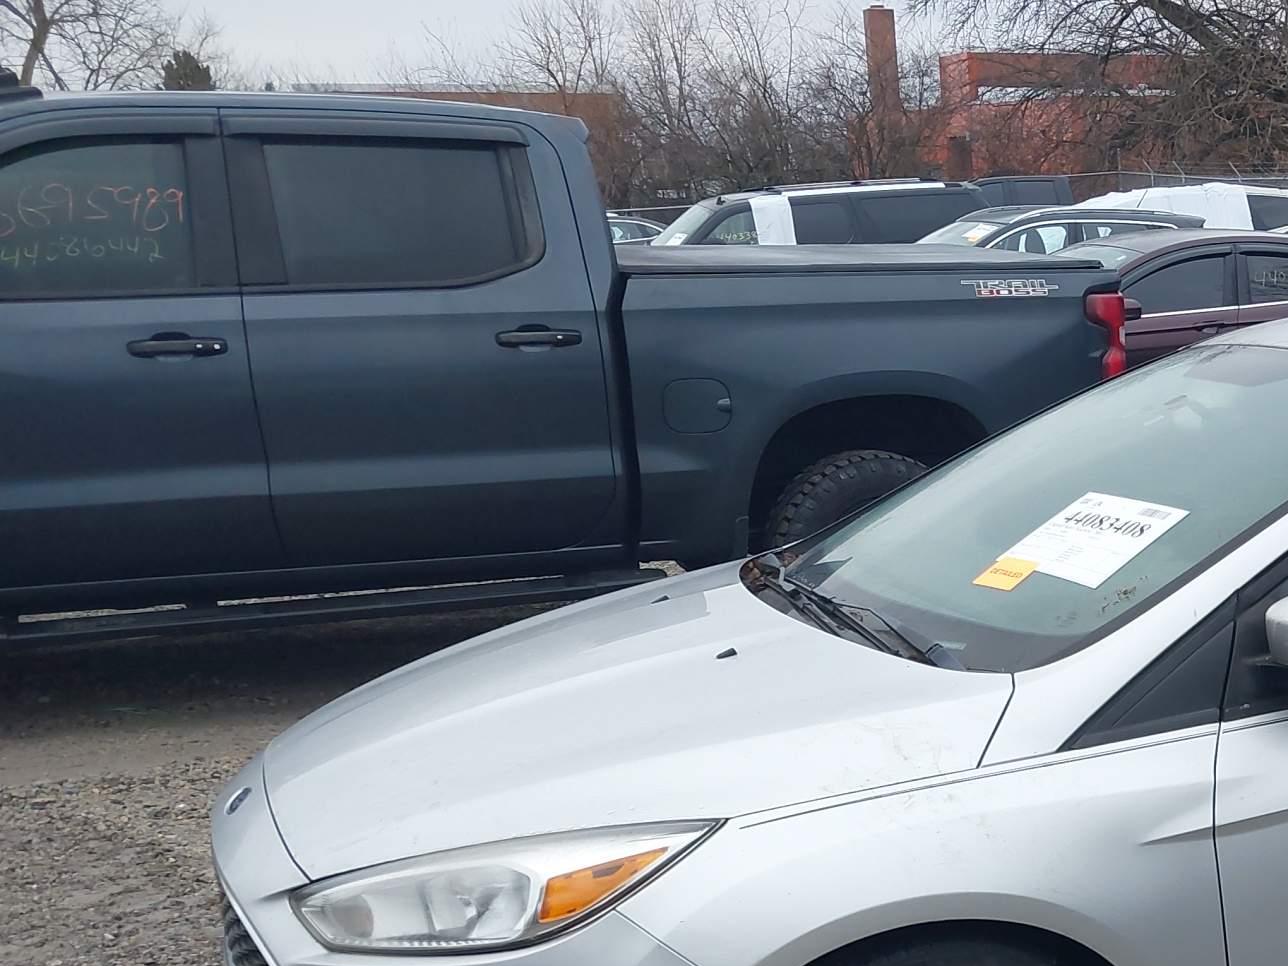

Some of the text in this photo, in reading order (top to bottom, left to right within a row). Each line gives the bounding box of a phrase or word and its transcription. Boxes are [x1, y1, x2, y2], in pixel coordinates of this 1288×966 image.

[960, 279, 1059, 290] TRAIL
[976, 288, 1049, 298] BOSS
[1064, 511, 1152, 538] 44083408
